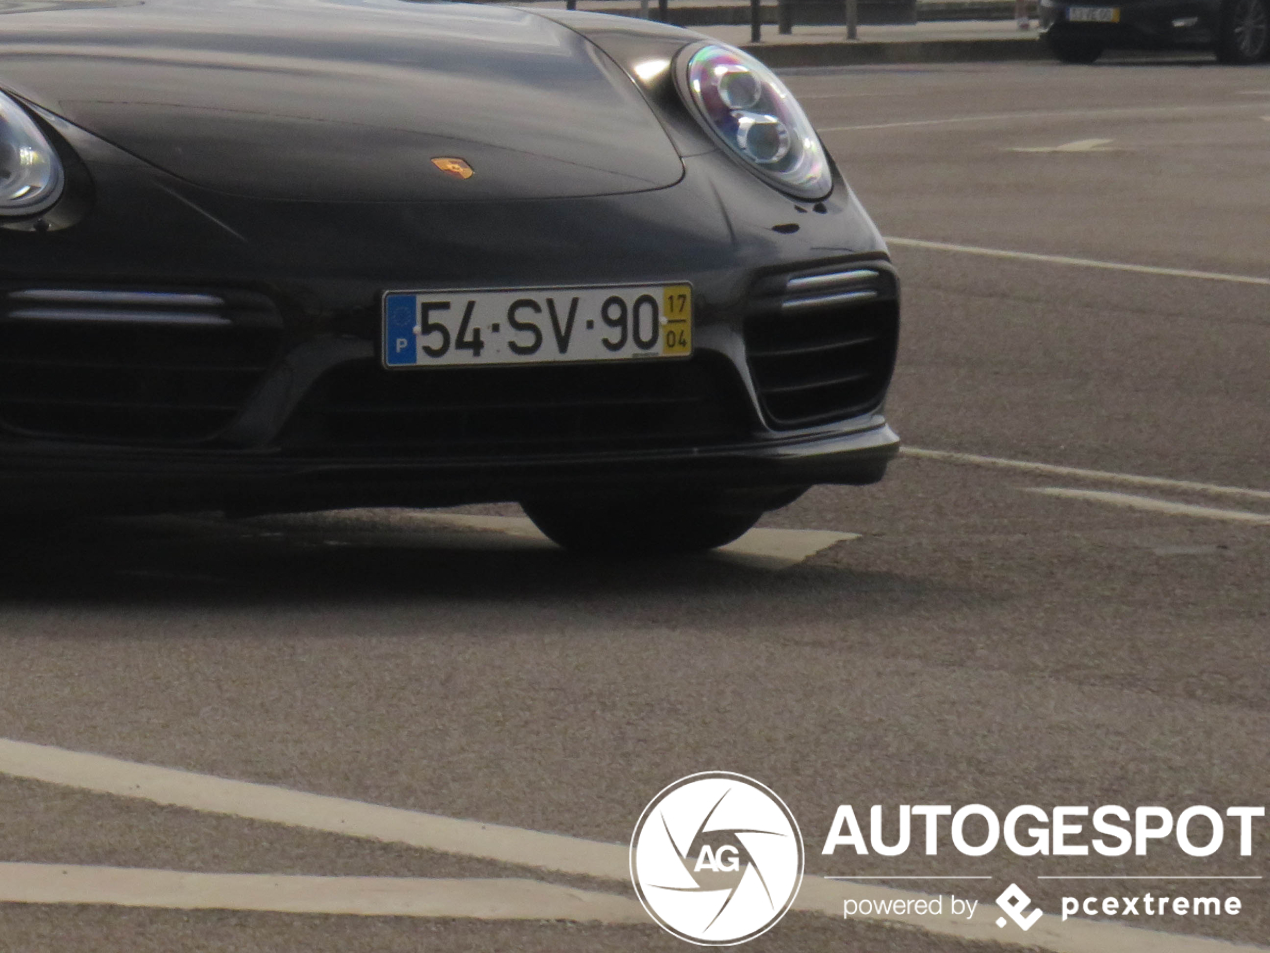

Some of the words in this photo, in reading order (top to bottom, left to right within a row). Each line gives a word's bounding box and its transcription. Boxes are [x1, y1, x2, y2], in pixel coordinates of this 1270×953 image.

[668, 294, 687, 314] 17
[395, 338, 408, 353] P
[666, 333, 687, 350] 04
